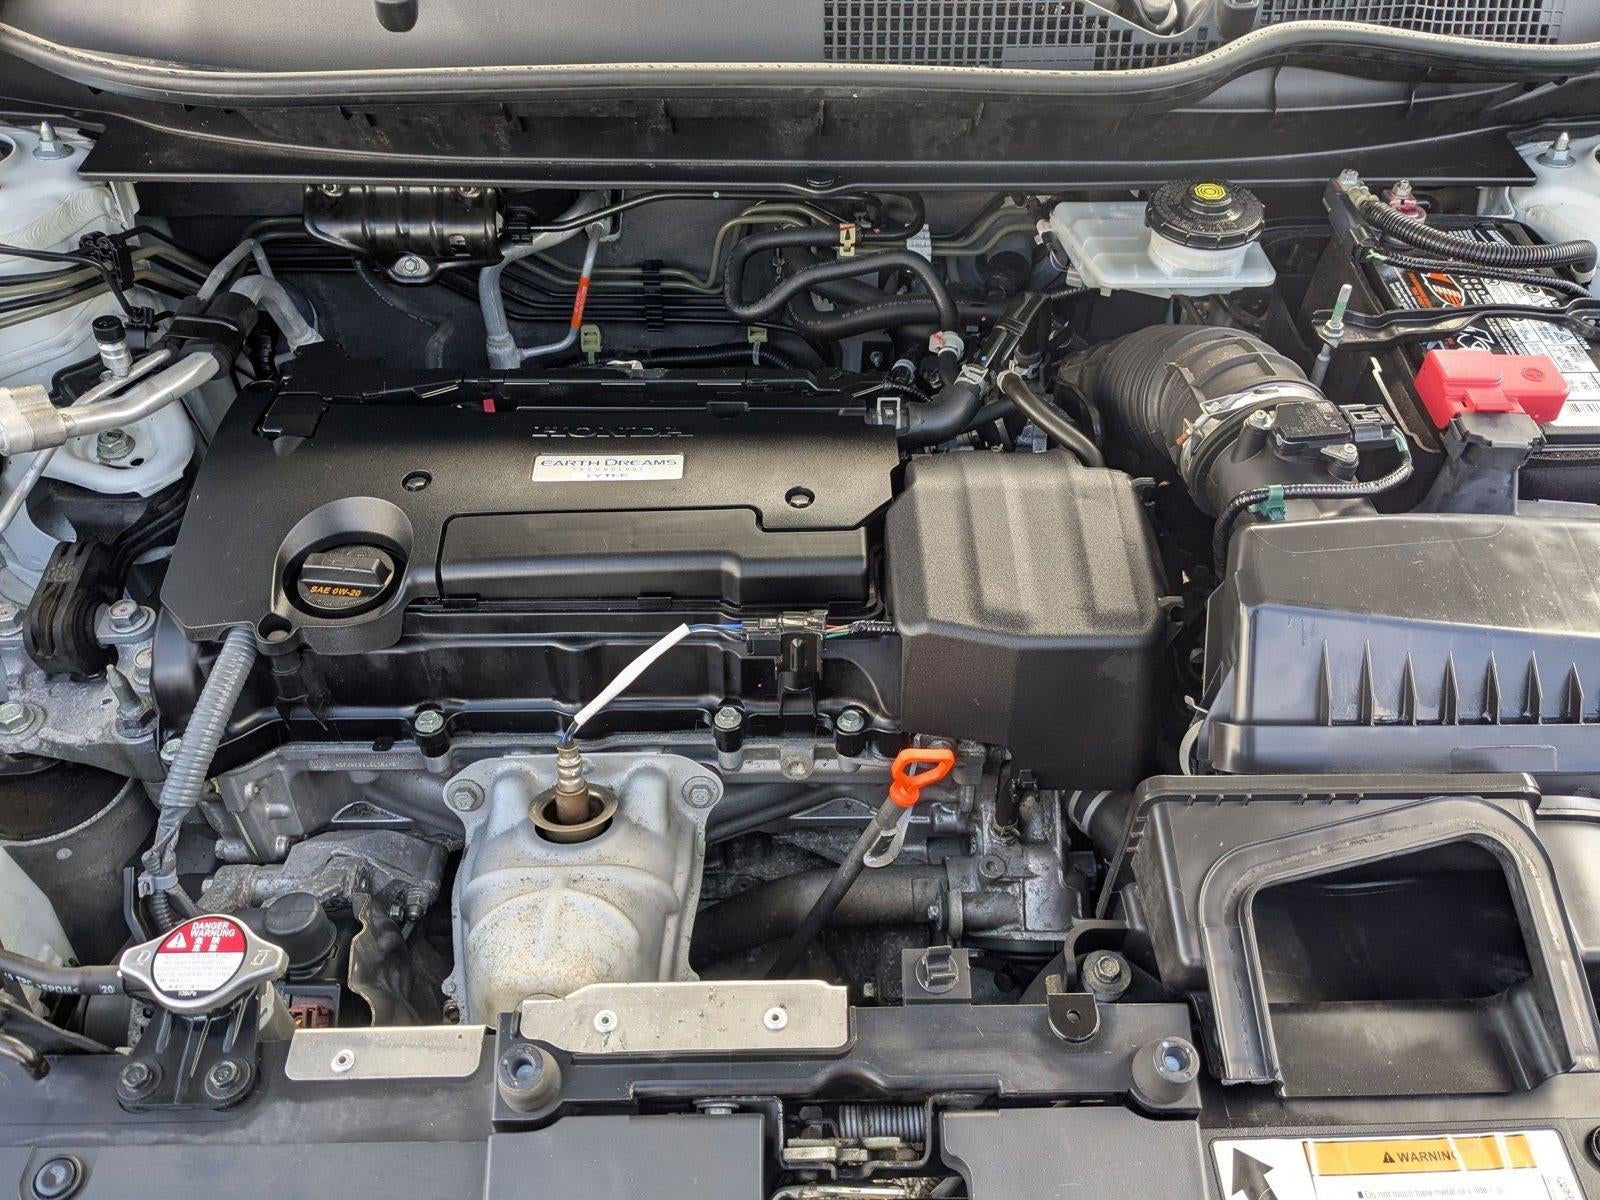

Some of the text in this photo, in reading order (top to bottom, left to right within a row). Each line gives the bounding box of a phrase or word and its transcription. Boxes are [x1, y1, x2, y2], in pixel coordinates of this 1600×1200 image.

[531, 426, 695, 438] HONDA
[540, 458, 678, 467] EARTH DREAMS
[310, 586, 362, 597] SAE 0W-20
[192, 921, 230, 930] DANGER
[190, 928, 236, 938] WARNUNG
[1364, 1190, 1377, 1199] Do
[1415, 1189, 1433, 1197] bare
[1434, 1187, 1456, 1197] metal
